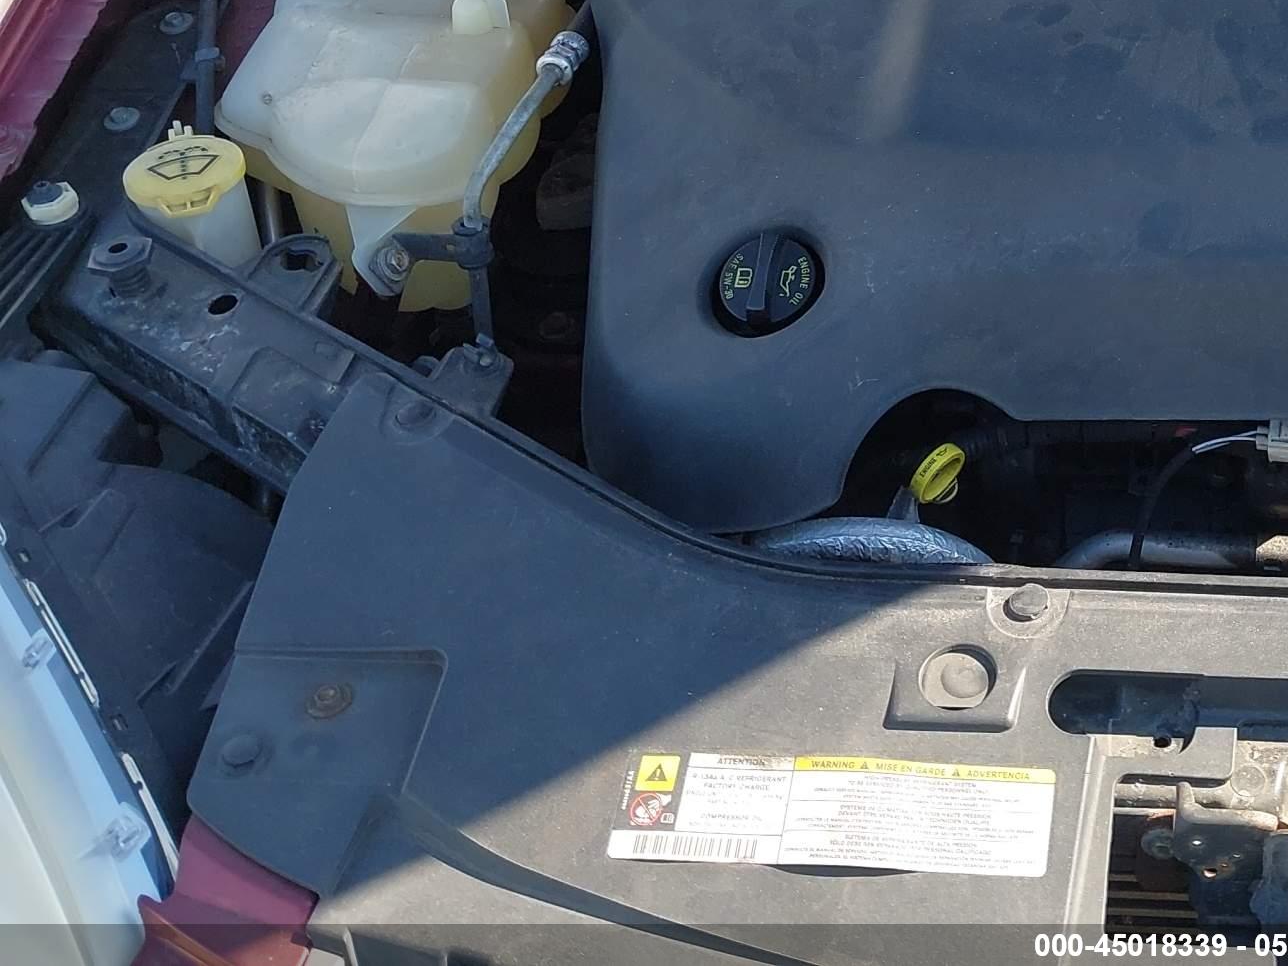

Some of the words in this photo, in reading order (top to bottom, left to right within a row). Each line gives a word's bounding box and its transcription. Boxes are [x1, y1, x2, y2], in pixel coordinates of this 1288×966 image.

[730, 253, 744, 271] SAE
[797, 256, 811, 290] ENGINE
[724, 272, 735, 300] 5W-30
[788, 291, 804, 306] OIL
[716, 757, 766, 766] ATTENTION
[811, 760, 856, 770] WARNING
[875, 763, 897, 772] MISE
[900, 765, 912, 773] EN
[915, 766, 946, 776] GARDE
[966, 769, 1031, 780] ADVERTENCIA
